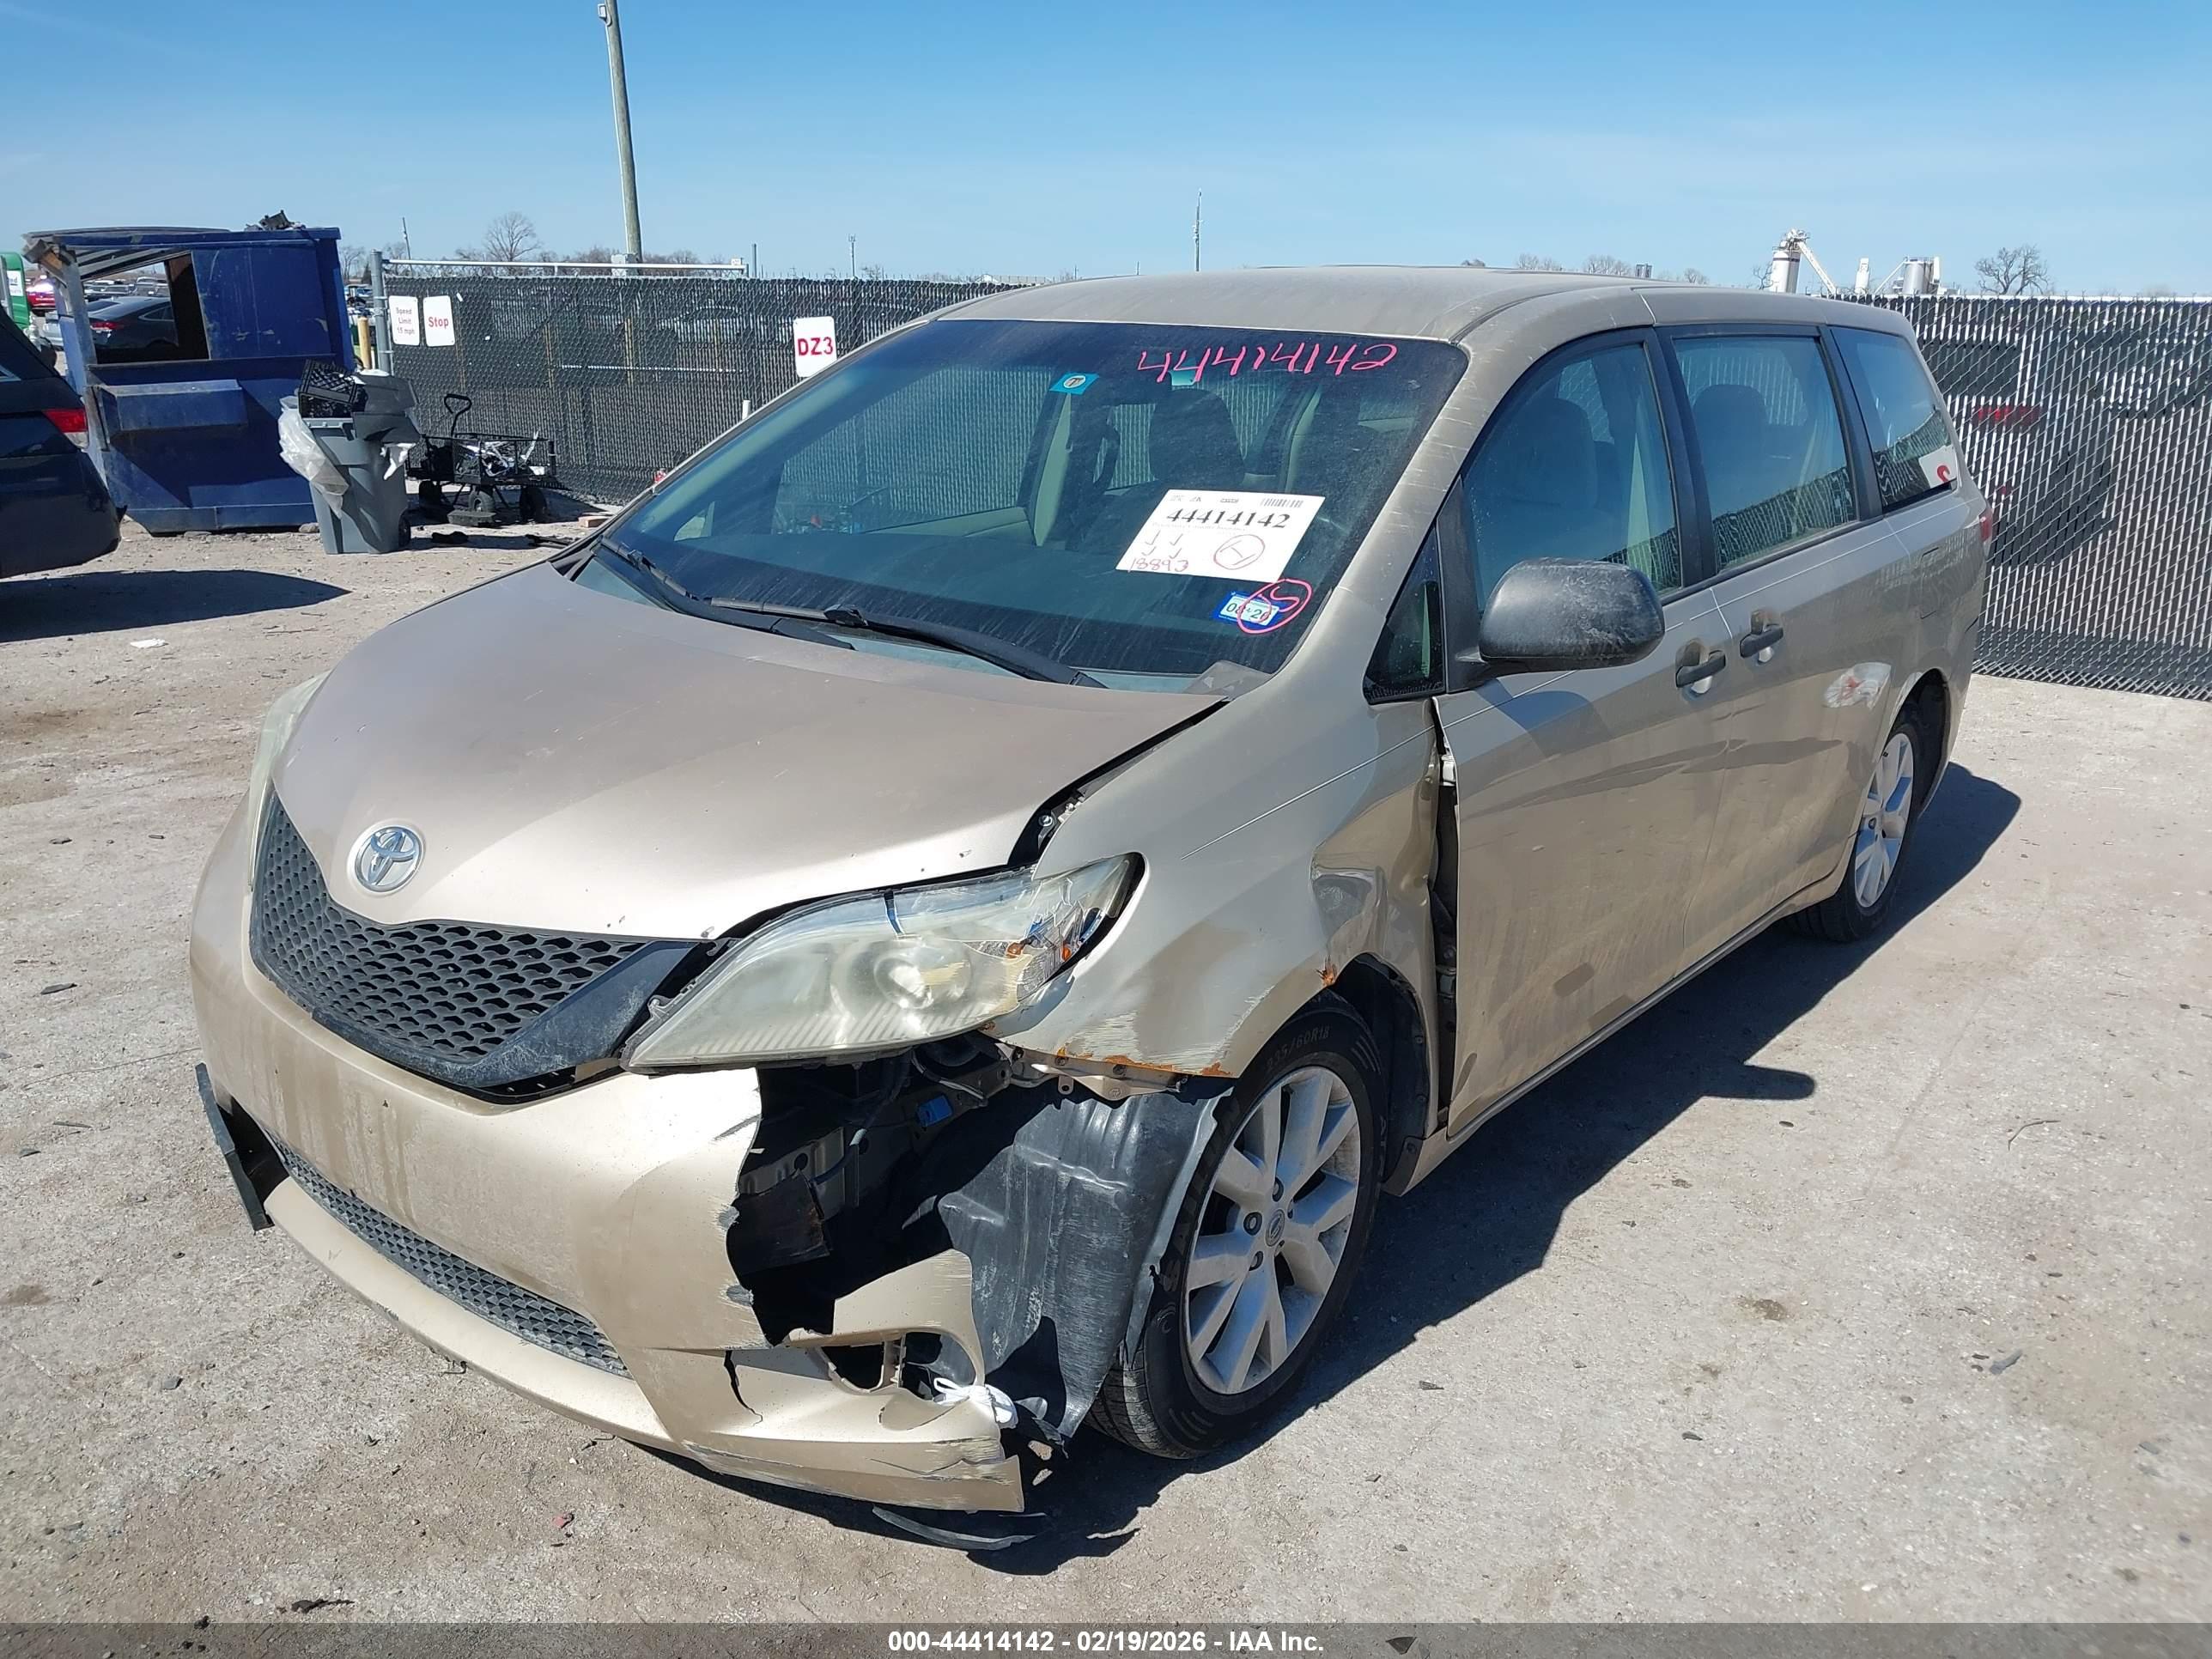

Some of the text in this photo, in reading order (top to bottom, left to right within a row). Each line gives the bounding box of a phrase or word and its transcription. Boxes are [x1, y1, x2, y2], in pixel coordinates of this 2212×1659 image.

[396, 307, 412, 315] Speed
[428, 316, 449, 329] Stop
[797, 336, 833, 356] DZ3
[1137, 343, 1398, 383] 44414142
[1167, 508, 1290, 528] 44414142
